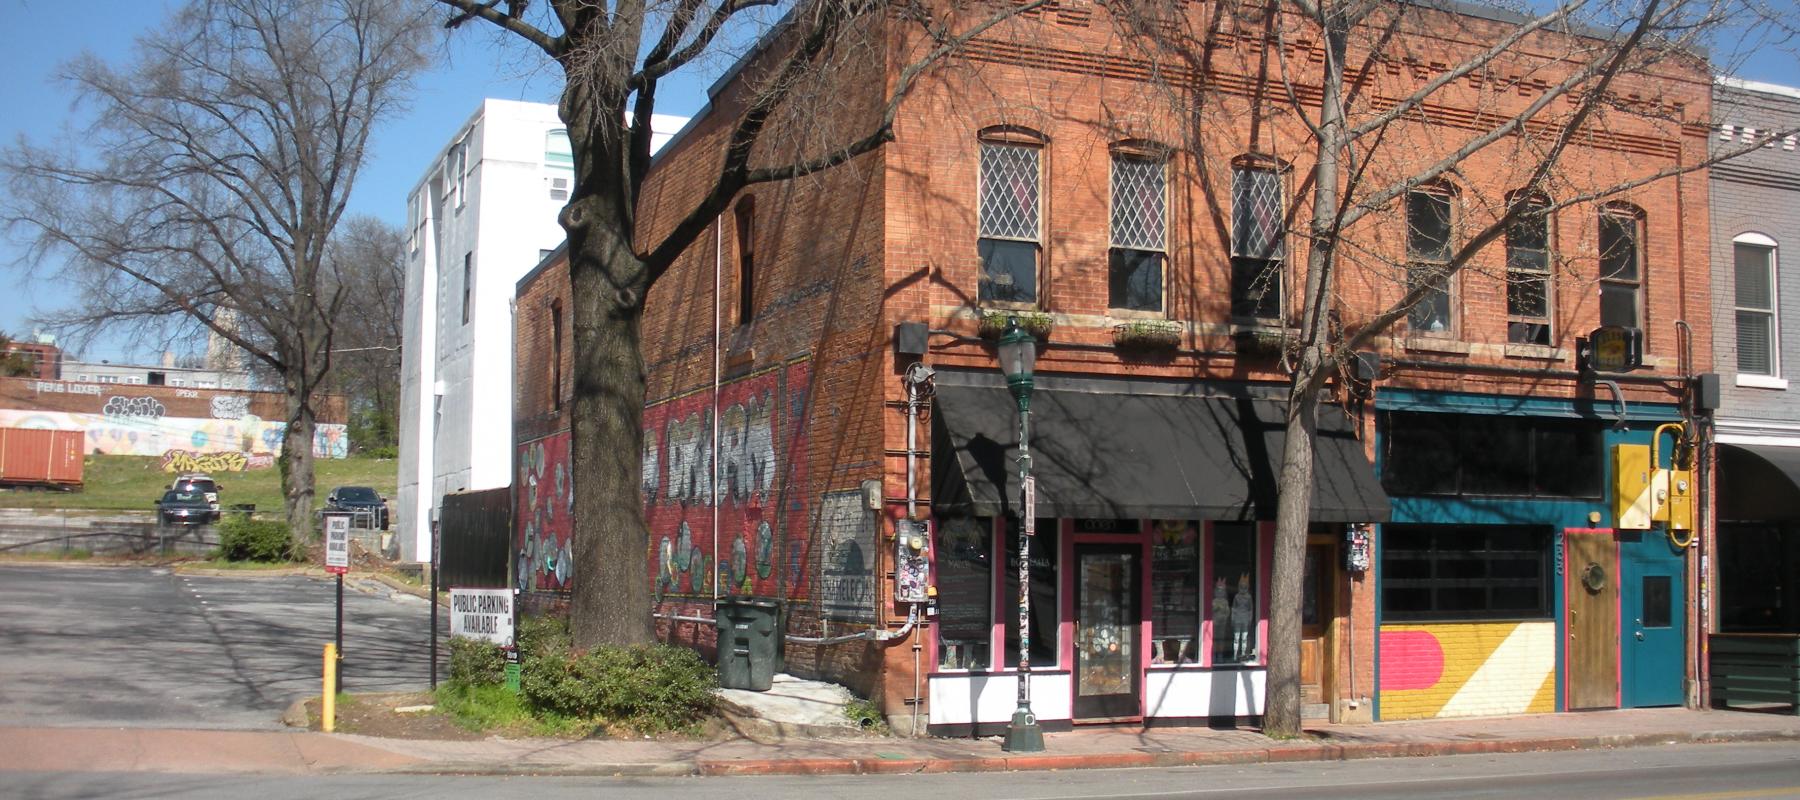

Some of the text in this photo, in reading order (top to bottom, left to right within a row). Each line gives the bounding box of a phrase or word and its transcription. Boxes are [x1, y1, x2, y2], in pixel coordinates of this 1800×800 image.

[453, 594, 509, 614] PUBLIC PARKING
[463, 614, 498, 634] AVAILABLE
